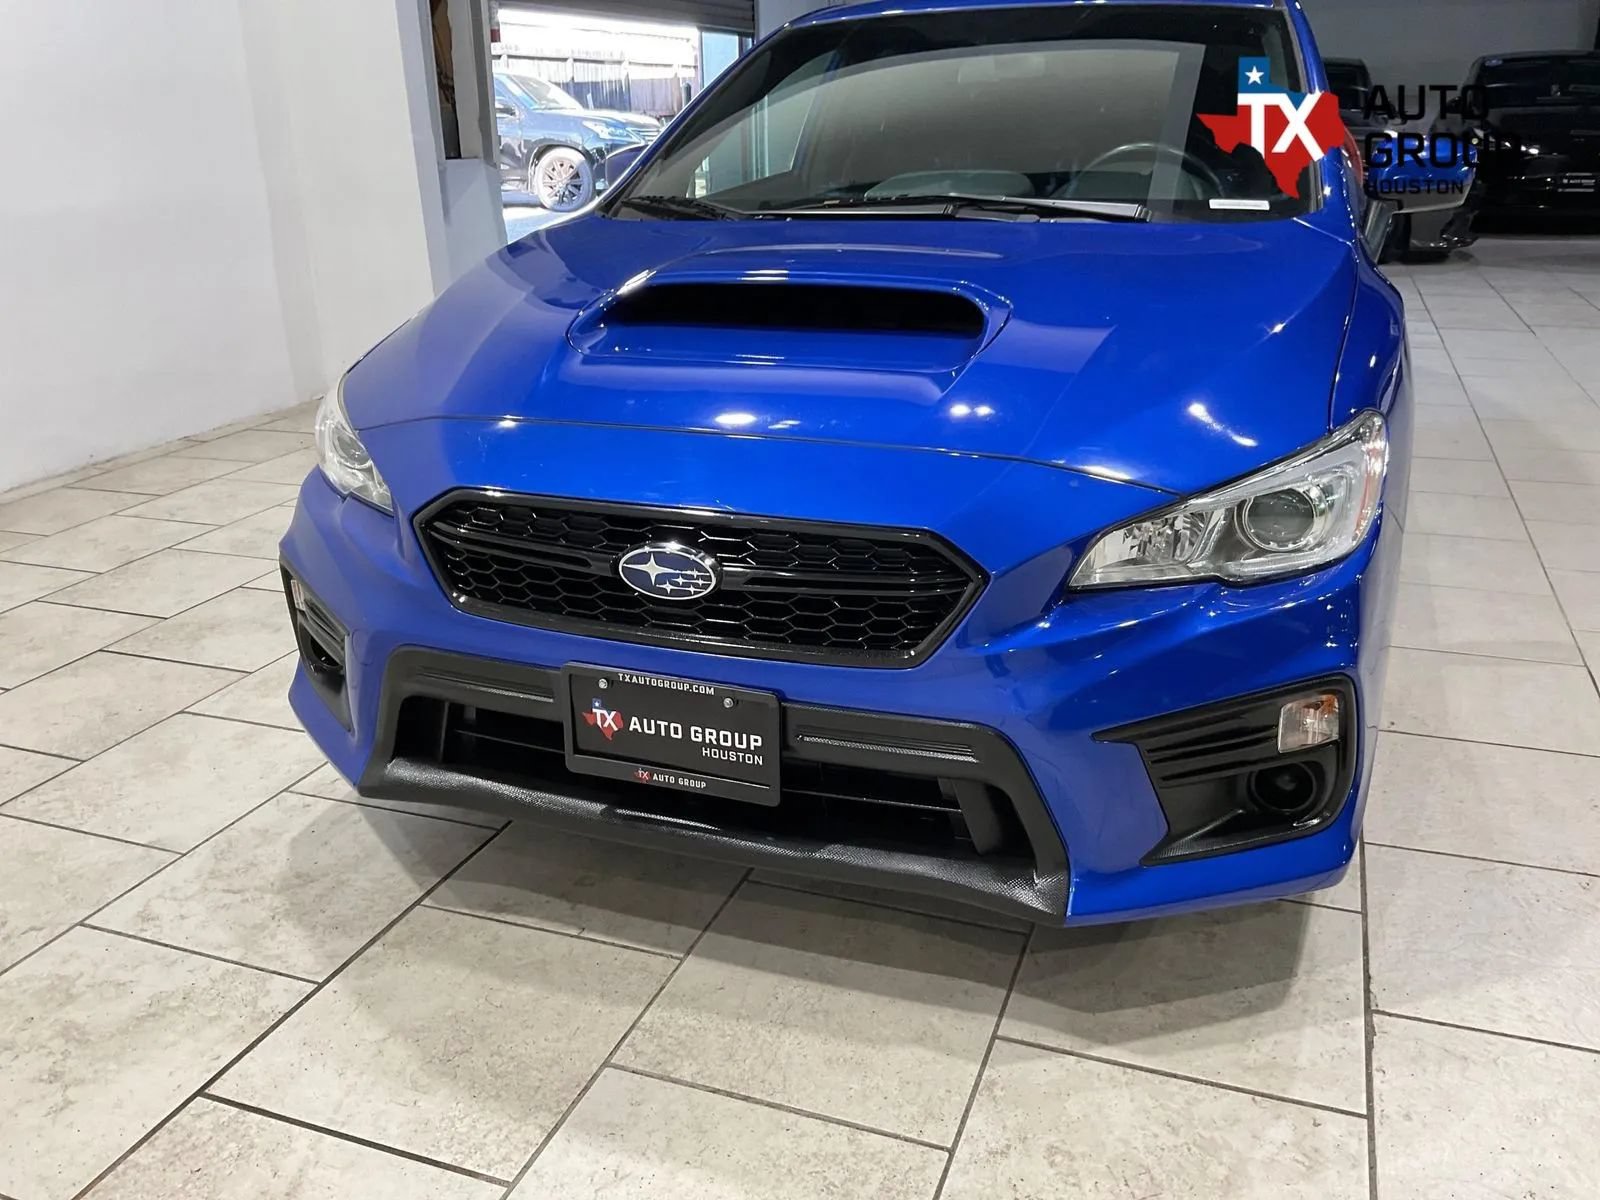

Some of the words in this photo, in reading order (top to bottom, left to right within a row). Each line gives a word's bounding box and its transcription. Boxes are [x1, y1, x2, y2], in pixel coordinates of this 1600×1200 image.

[617, 673, 715, 696] TXAUTOGROUP.COM
[592, 708, 619, 732] TX
[628, 716, 683, 739] AUTO
[690, 725, 763, 751] GROUP
[701, 747, 764, 766] HOUSTON
[652, 772, 676, 784] AUTO
[678, 777, 707, 789] GROUP
